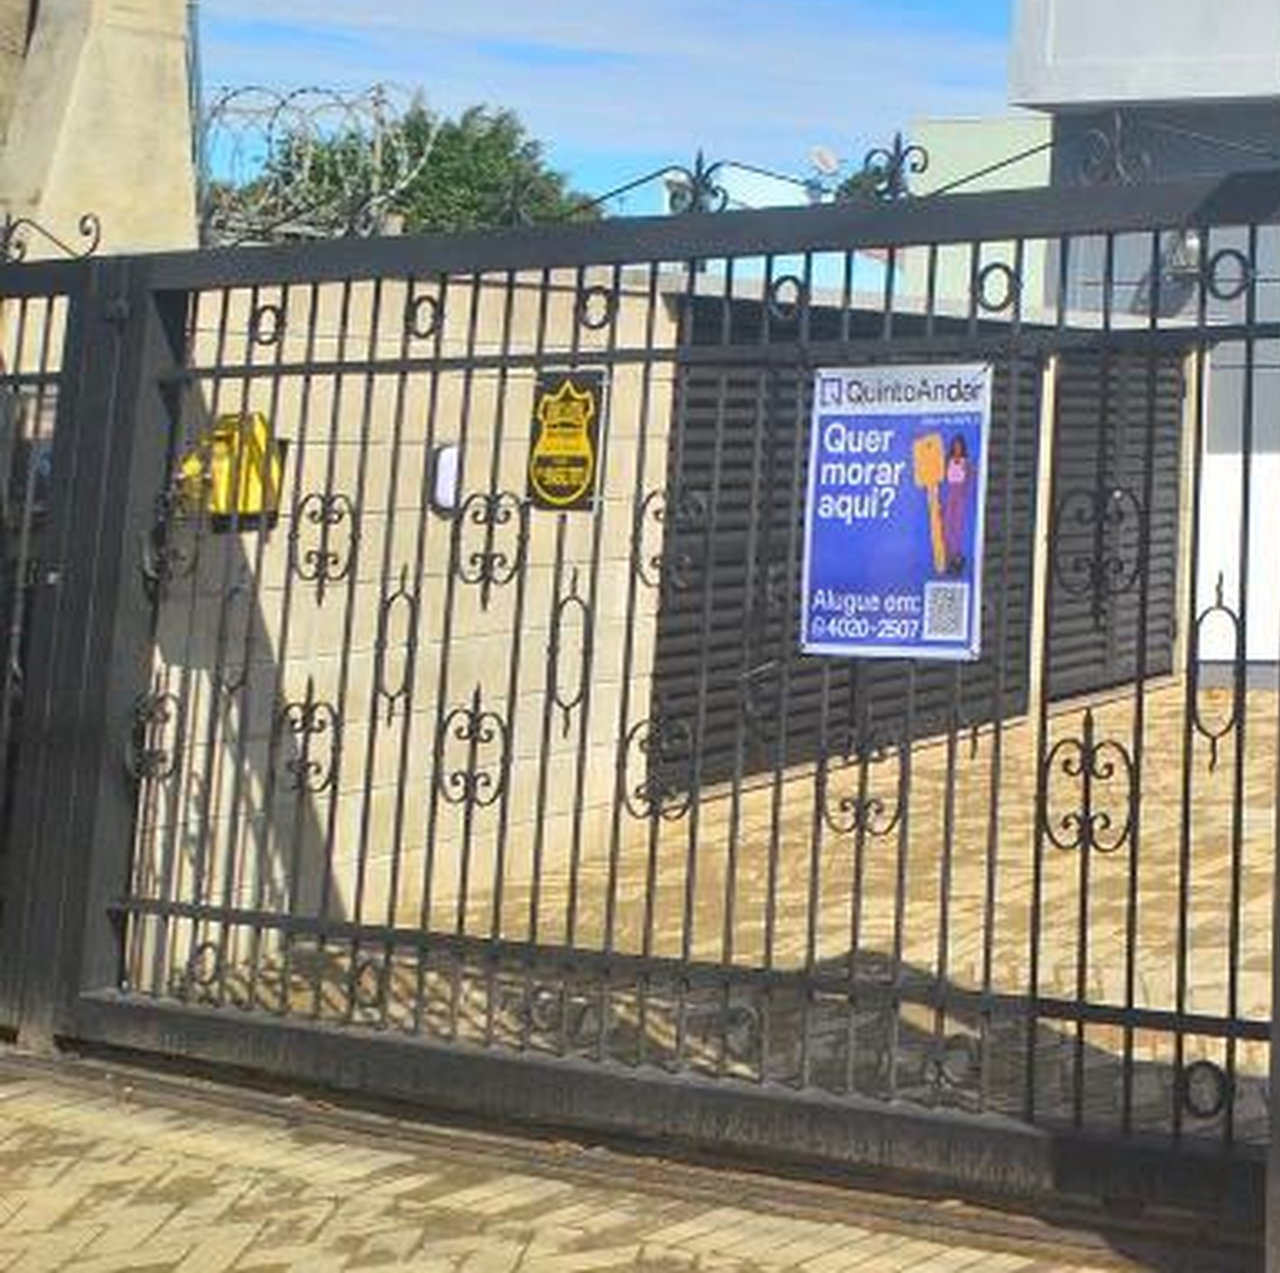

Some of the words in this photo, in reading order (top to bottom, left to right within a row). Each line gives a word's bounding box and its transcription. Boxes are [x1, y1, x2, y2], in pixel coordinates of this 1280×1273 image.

[823, 422, 894, 454] Quer
[820, 460, 906, 487] morar
[817, 487, 897, 524] aqui?
[811, 588, 880, 616] Alugue
